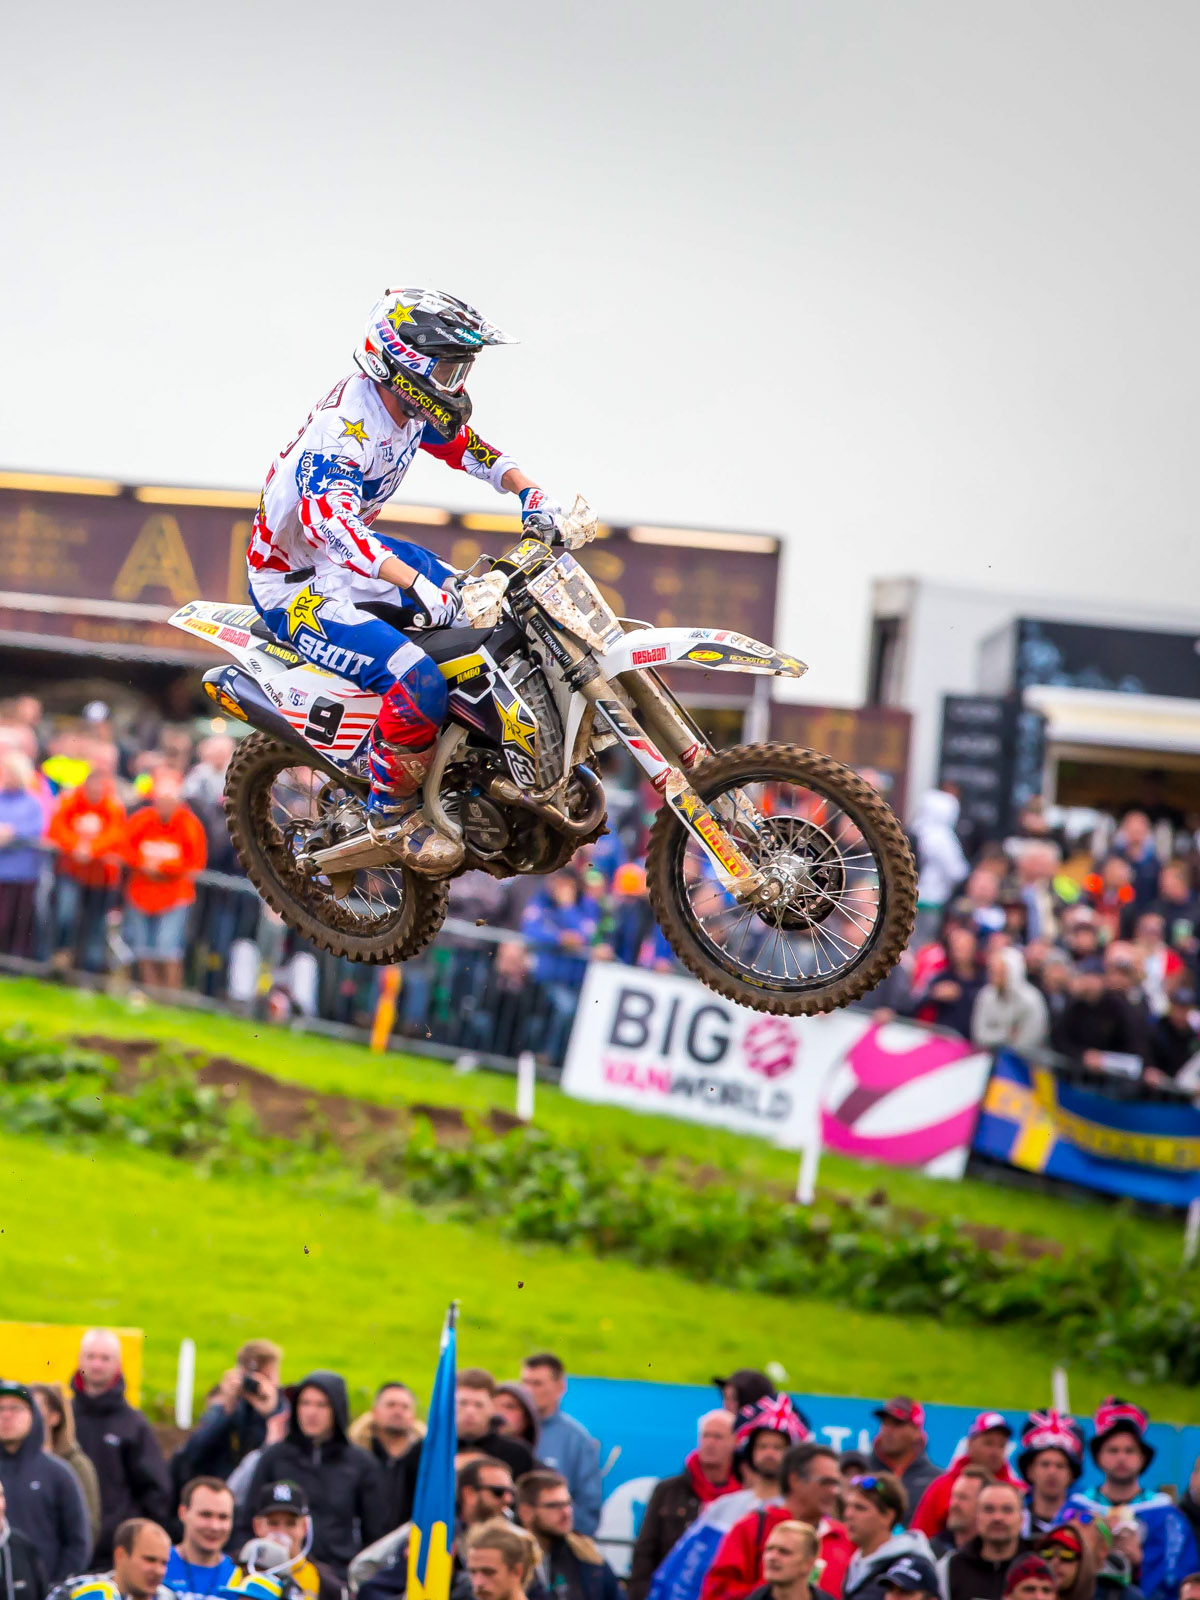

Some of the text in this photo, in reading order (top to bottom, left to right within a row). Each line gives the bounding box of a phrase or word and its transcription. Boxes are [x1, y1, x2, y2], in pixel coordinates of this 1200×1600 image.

[375, 317, 427, 370] 100%
[264, 643, 299, 664] JUMBO
[299, 633, 375, 676] SHOT
[456, 666, 481, 685] JUMBO
[307, 695, 345, 746] 9
[608, 986, 732, 1064] BIG
[601, 1055, 793, 1122] VANWORLD
